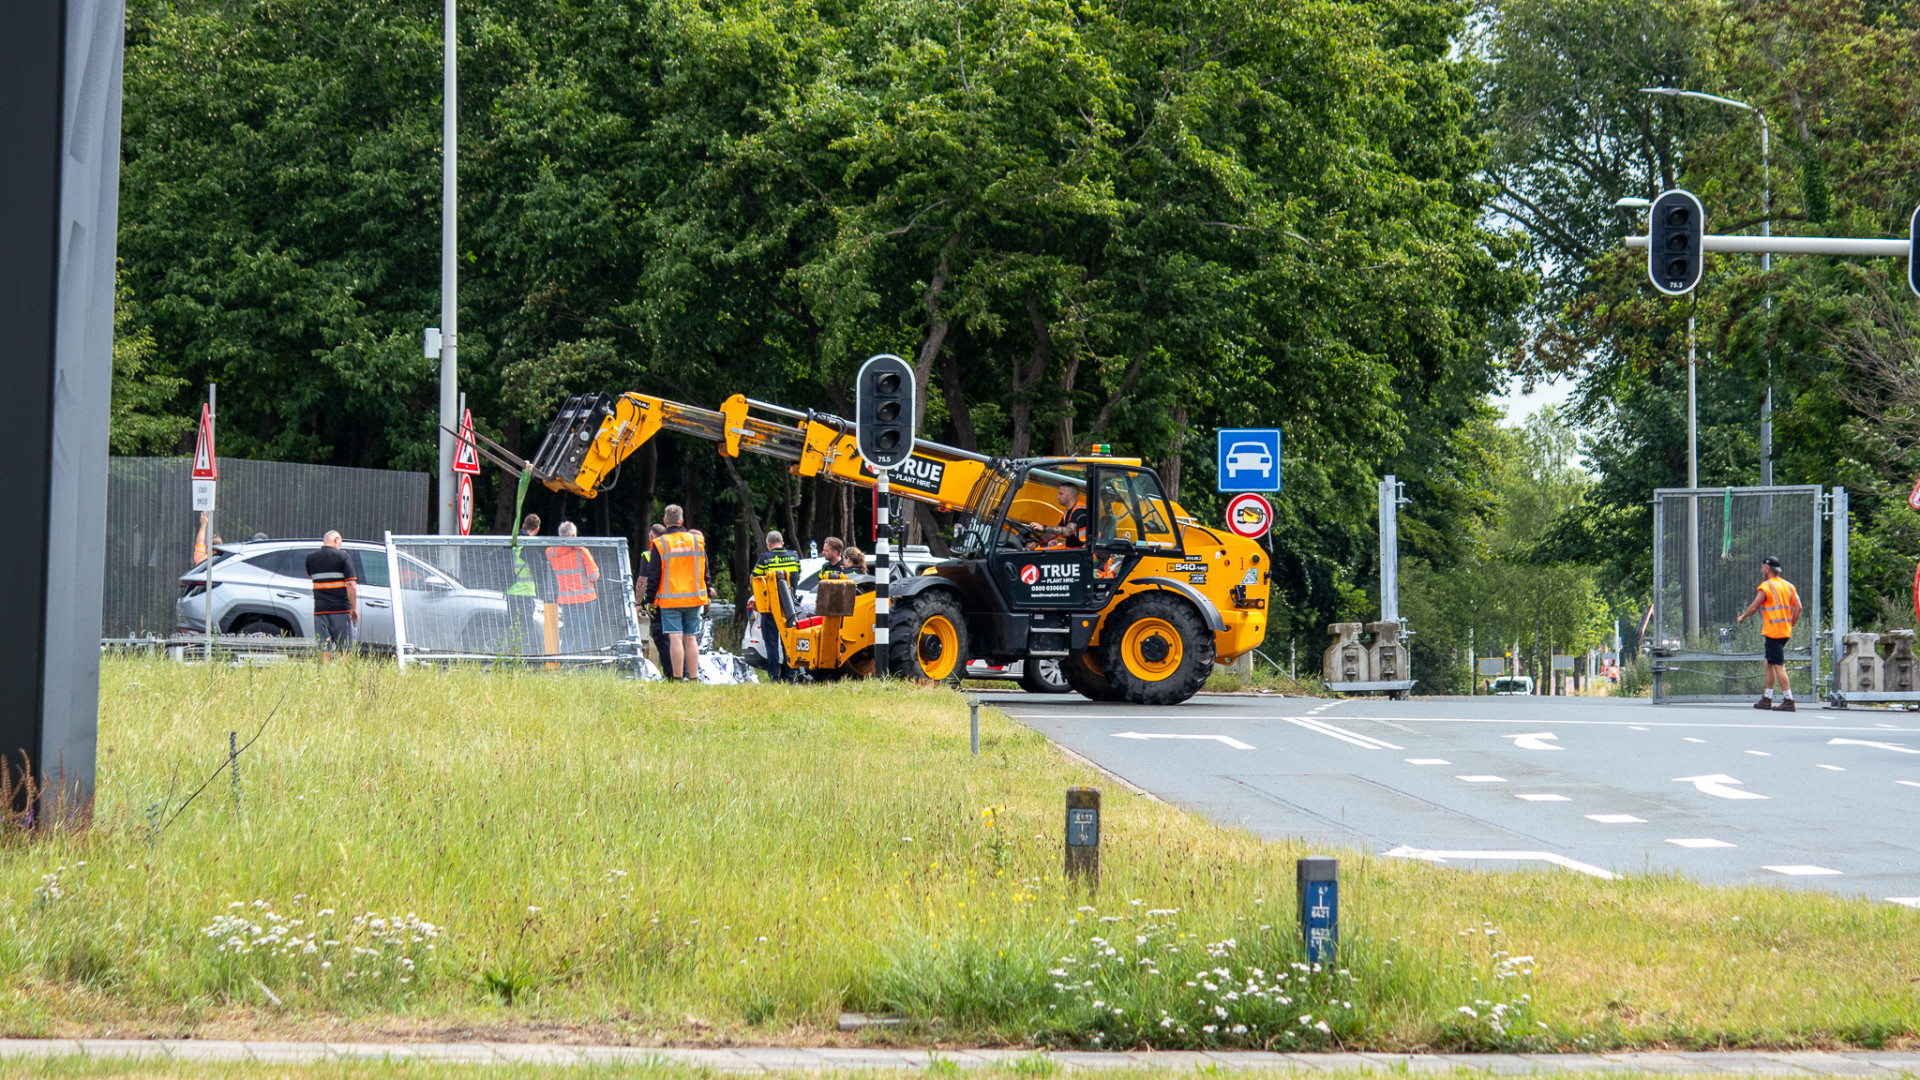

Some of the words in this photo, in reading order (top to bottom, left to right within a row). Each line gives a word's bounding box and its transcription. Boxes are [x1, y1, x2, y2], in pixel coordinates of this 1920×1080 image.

[877, 455, 891, 463] 75.5
[895, 473, 917, 485] PLANT
[916, 478, 932, 488] HIRE
[462, 495, 470, 520] 30
[1040, 563, 1081, 578] TRUE
[1175, 563, 1207, 571] 540-140
[797, 638, 810, 651] JCB
